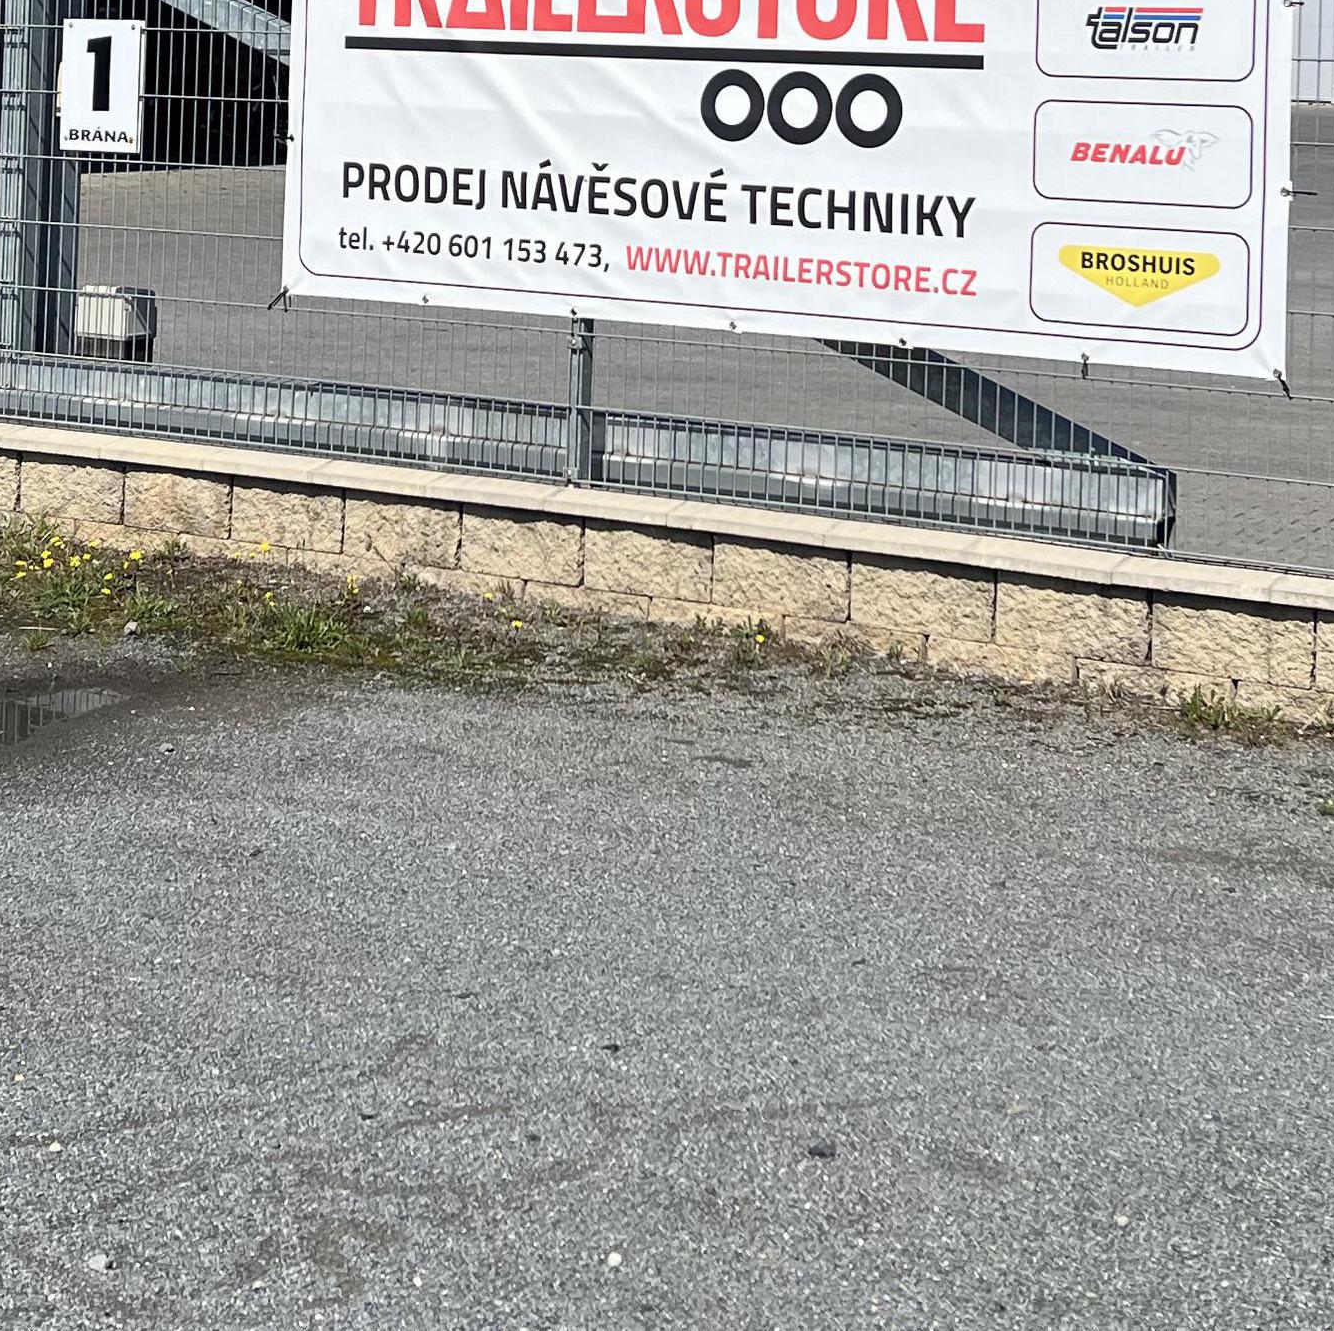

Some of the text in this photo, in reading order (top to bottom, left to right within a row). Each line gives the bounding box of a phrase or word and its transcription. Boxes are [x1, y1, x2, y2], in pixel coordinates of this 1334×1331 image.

[1085, 7, 1200, 49] talson
[87, 36, 112, 111] 1
[69, 127, 129, 143] BRÁNA
[1070, 142, 1186, 166] BENALU
[342, 159, 976, 238] PRODEJ NÁVĚSOVÉ TECHNIKY
[339, 227, 977, 296] tel. +420 601 153 473, WWW.TRAILERSTORE.CZ
[1081, 251, 1195, 276] BROSHUIS
[1105, 276, 1169, 290] HOLLAND
